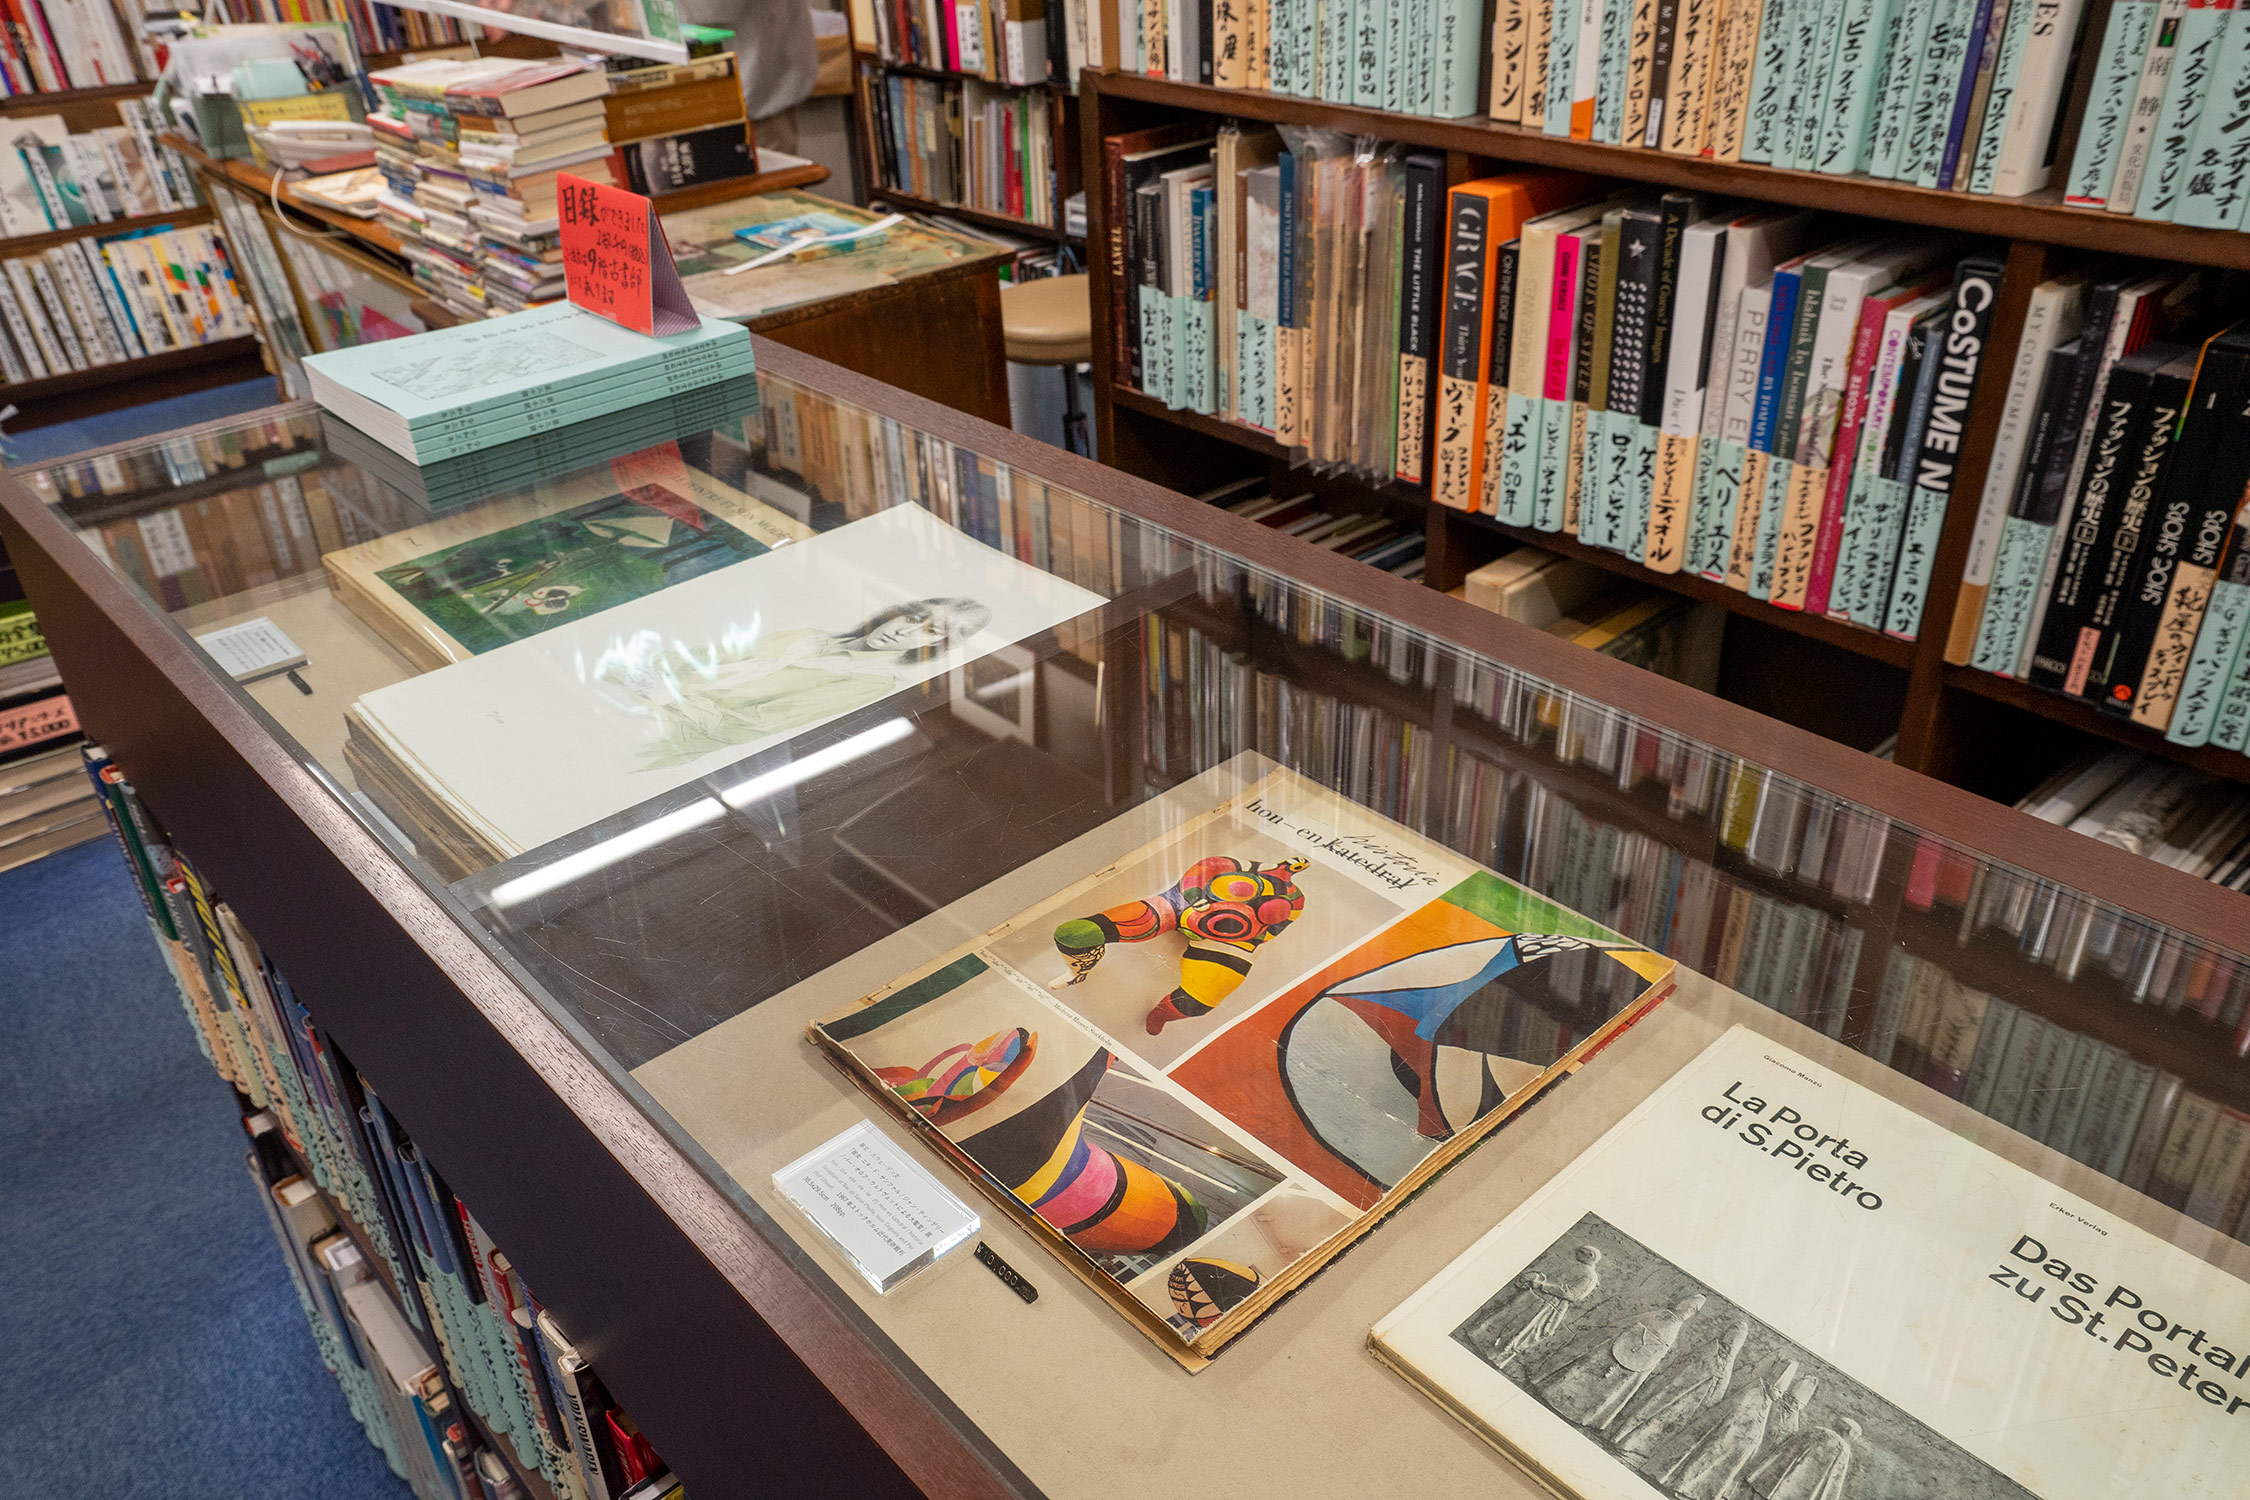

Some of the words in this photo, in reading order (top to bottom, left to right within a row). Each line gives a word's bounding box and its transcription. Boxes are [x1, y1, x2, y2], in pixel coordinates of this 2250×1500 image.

[1412, 249, 1423, 272] THE
[1410, 274, 1422, 314] LITTLE
[1733, 309, 1765, 405] PERRY
[1872, 329, 1900, 431] CONTEMPORARY
[2191, 509, 2228, 566] SHOPS
[1245, 798, 1285, 826] hon
[1087, 1027, 1113, 1048] Stockholm
[1763, 1053, 1798, 1077] Giacomo
[1700, 1103, 1742, 1131] di
[1721, 1080, 1768, 1115] La
[1768, 1103, 1871, 1171] Porta
[1988, 1264, 2047, 1304] zu
[2008, 1234, 2096, 1296] Das
[2105, 1285, 2250, 1381] Portal
